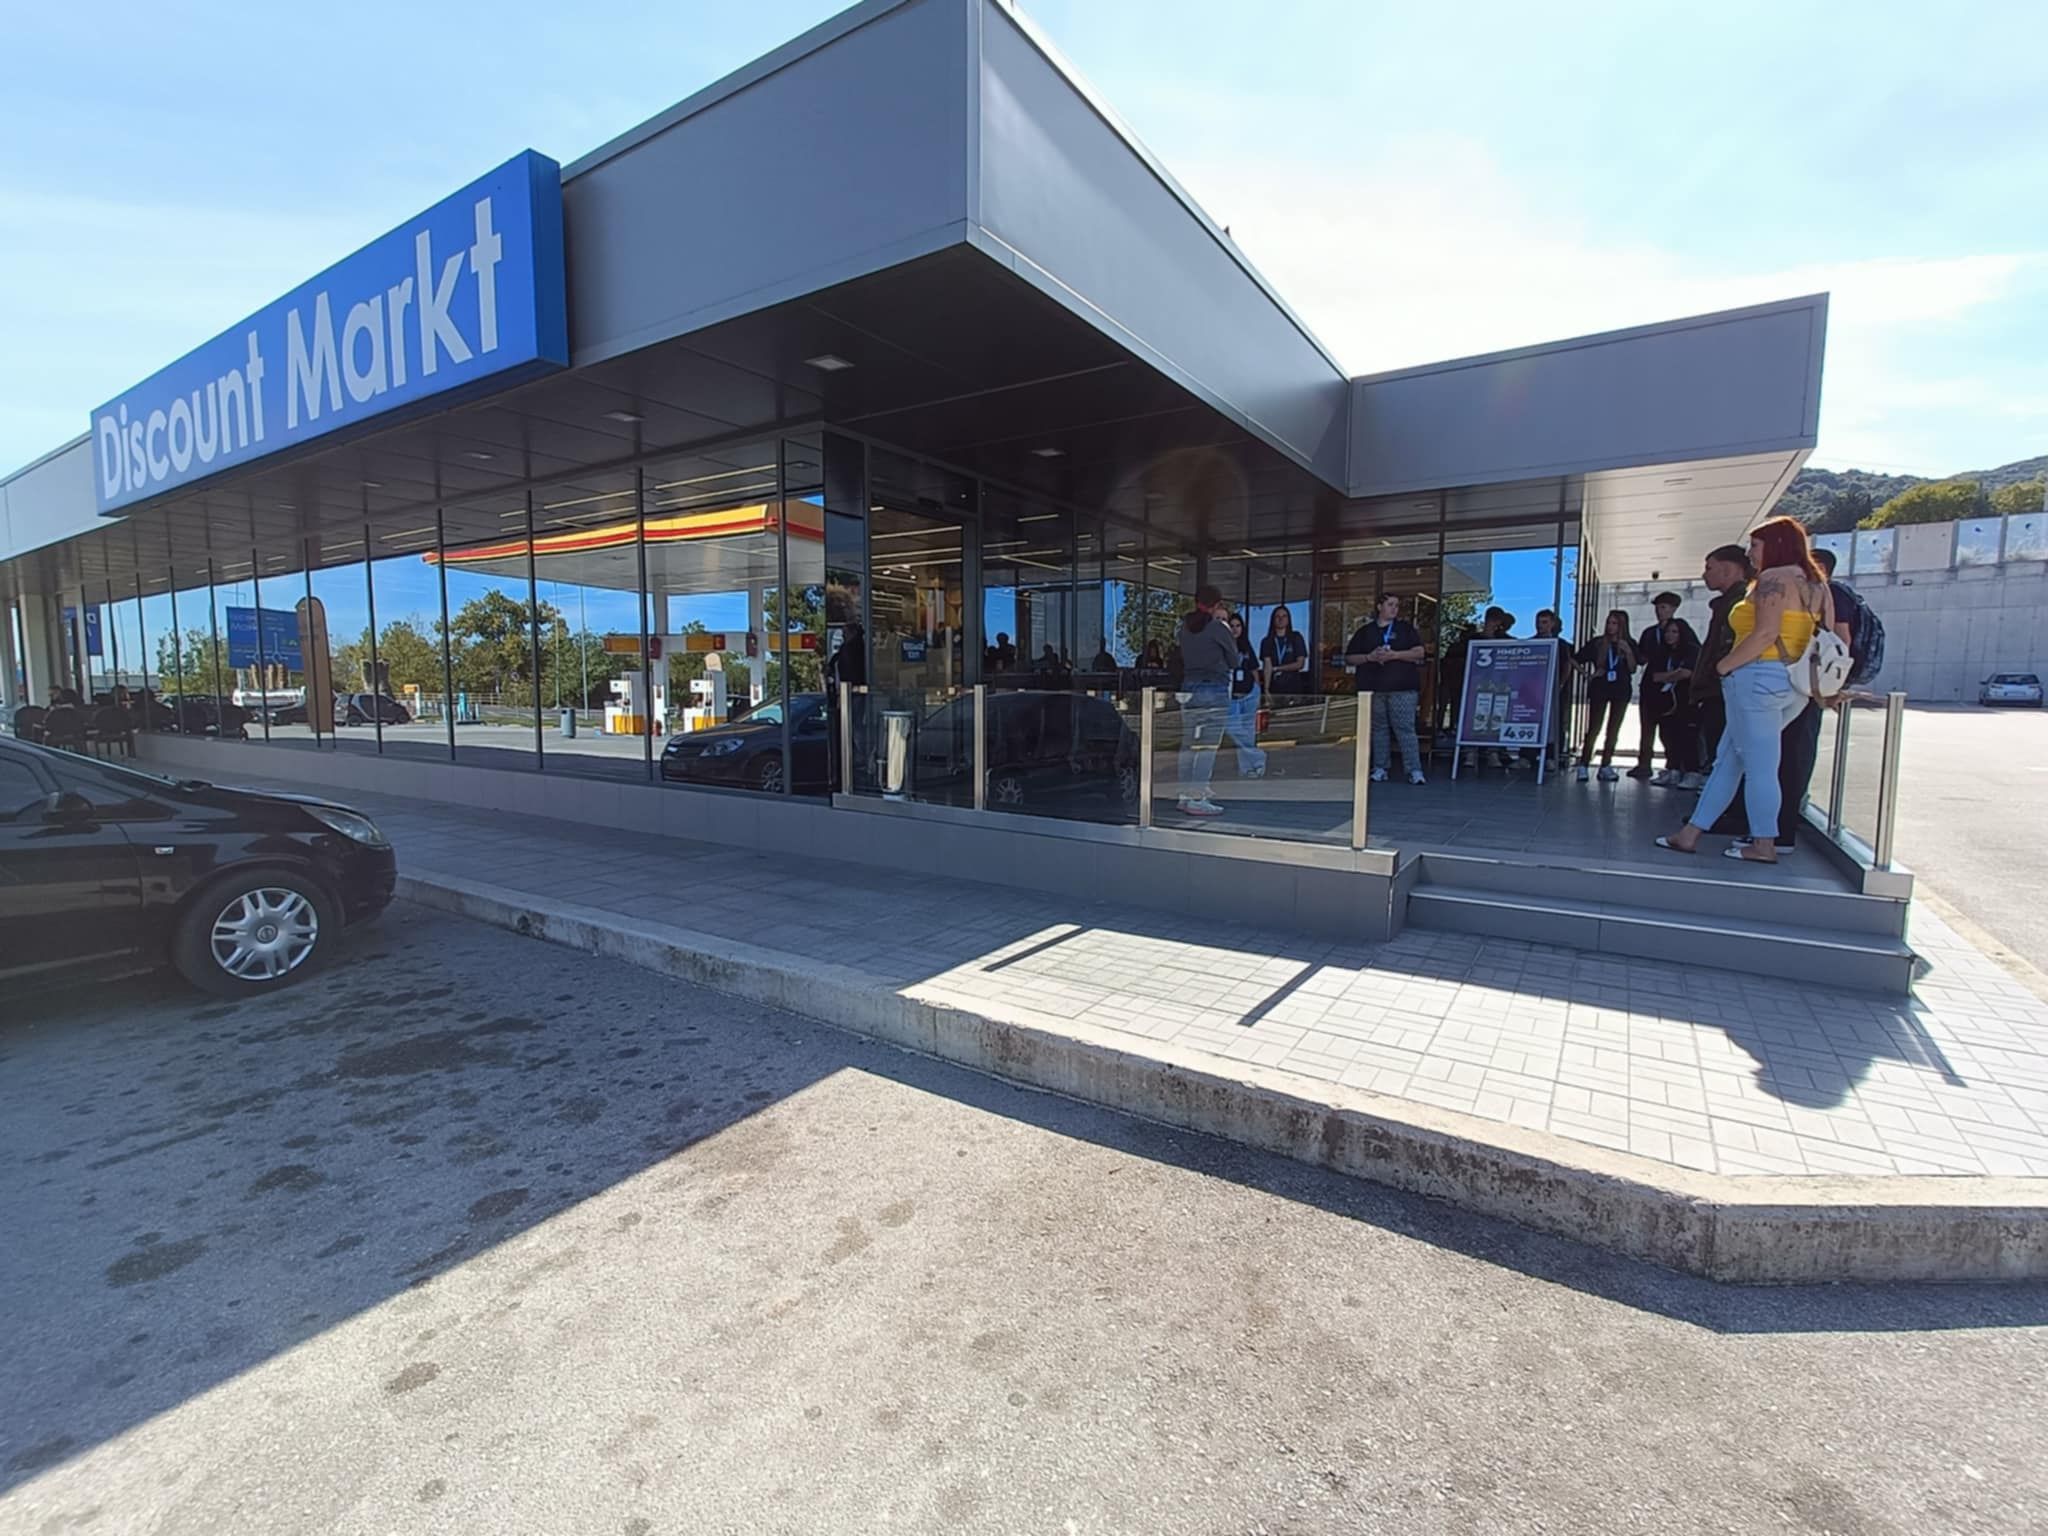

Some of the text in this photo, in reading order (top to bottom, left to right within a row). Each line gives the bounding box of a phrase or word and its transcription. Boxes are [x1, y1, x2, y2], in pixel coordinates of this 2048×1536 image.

[100, 196, 502, 500] Discount Markt
[1476, 648, 1493, 667] 3
[1504, 727, 1534, 739] 4.99
